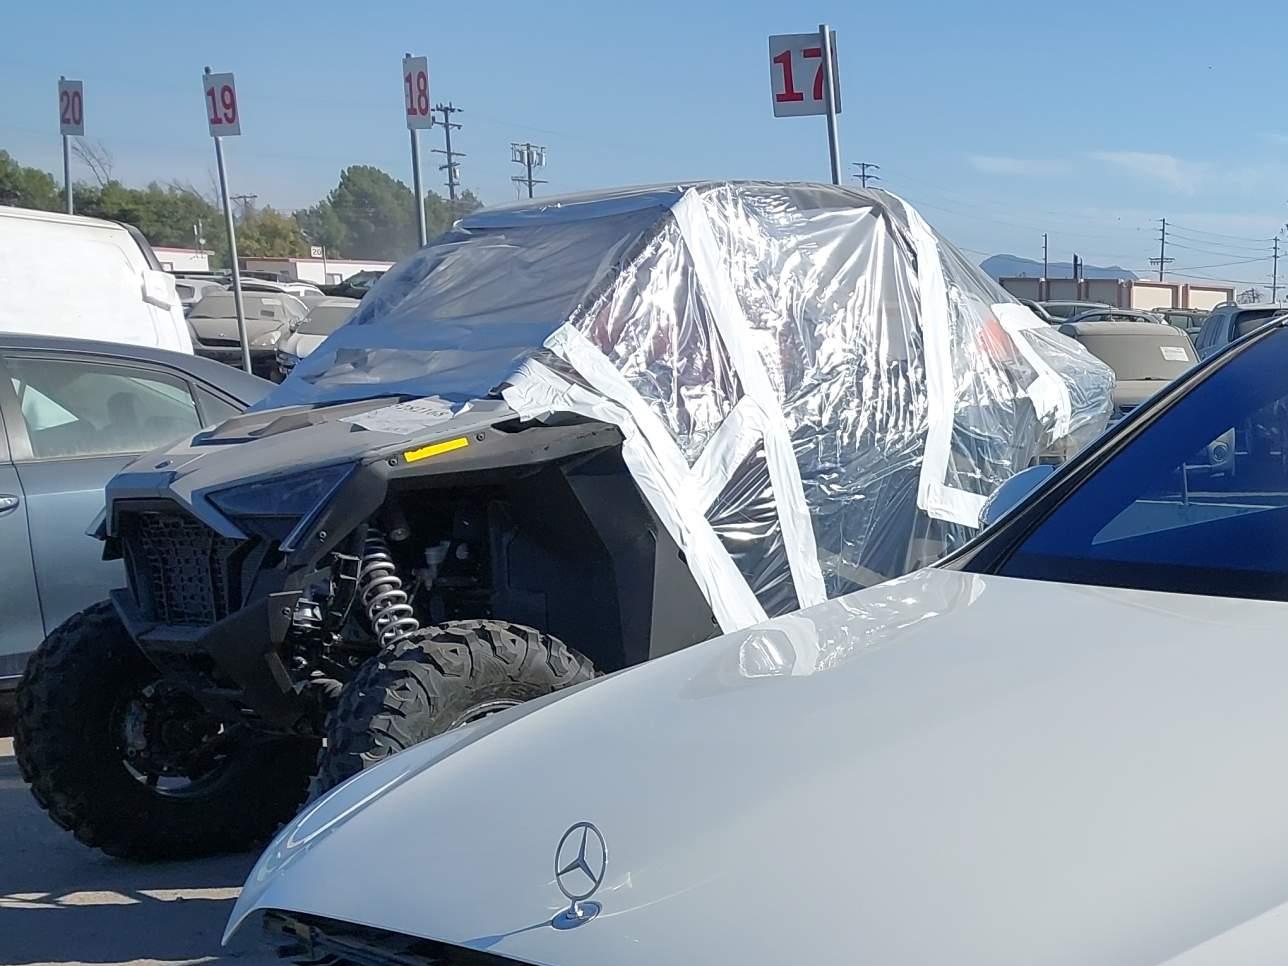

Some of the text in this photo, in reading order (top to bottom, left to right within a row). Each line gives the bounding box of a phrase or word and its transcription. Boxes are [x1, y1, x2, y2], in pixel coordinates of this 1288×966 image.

[60, 91, 83, 125] 20
[206, 85, 236, 124] 19
[405, 71, 429, 116] 18
